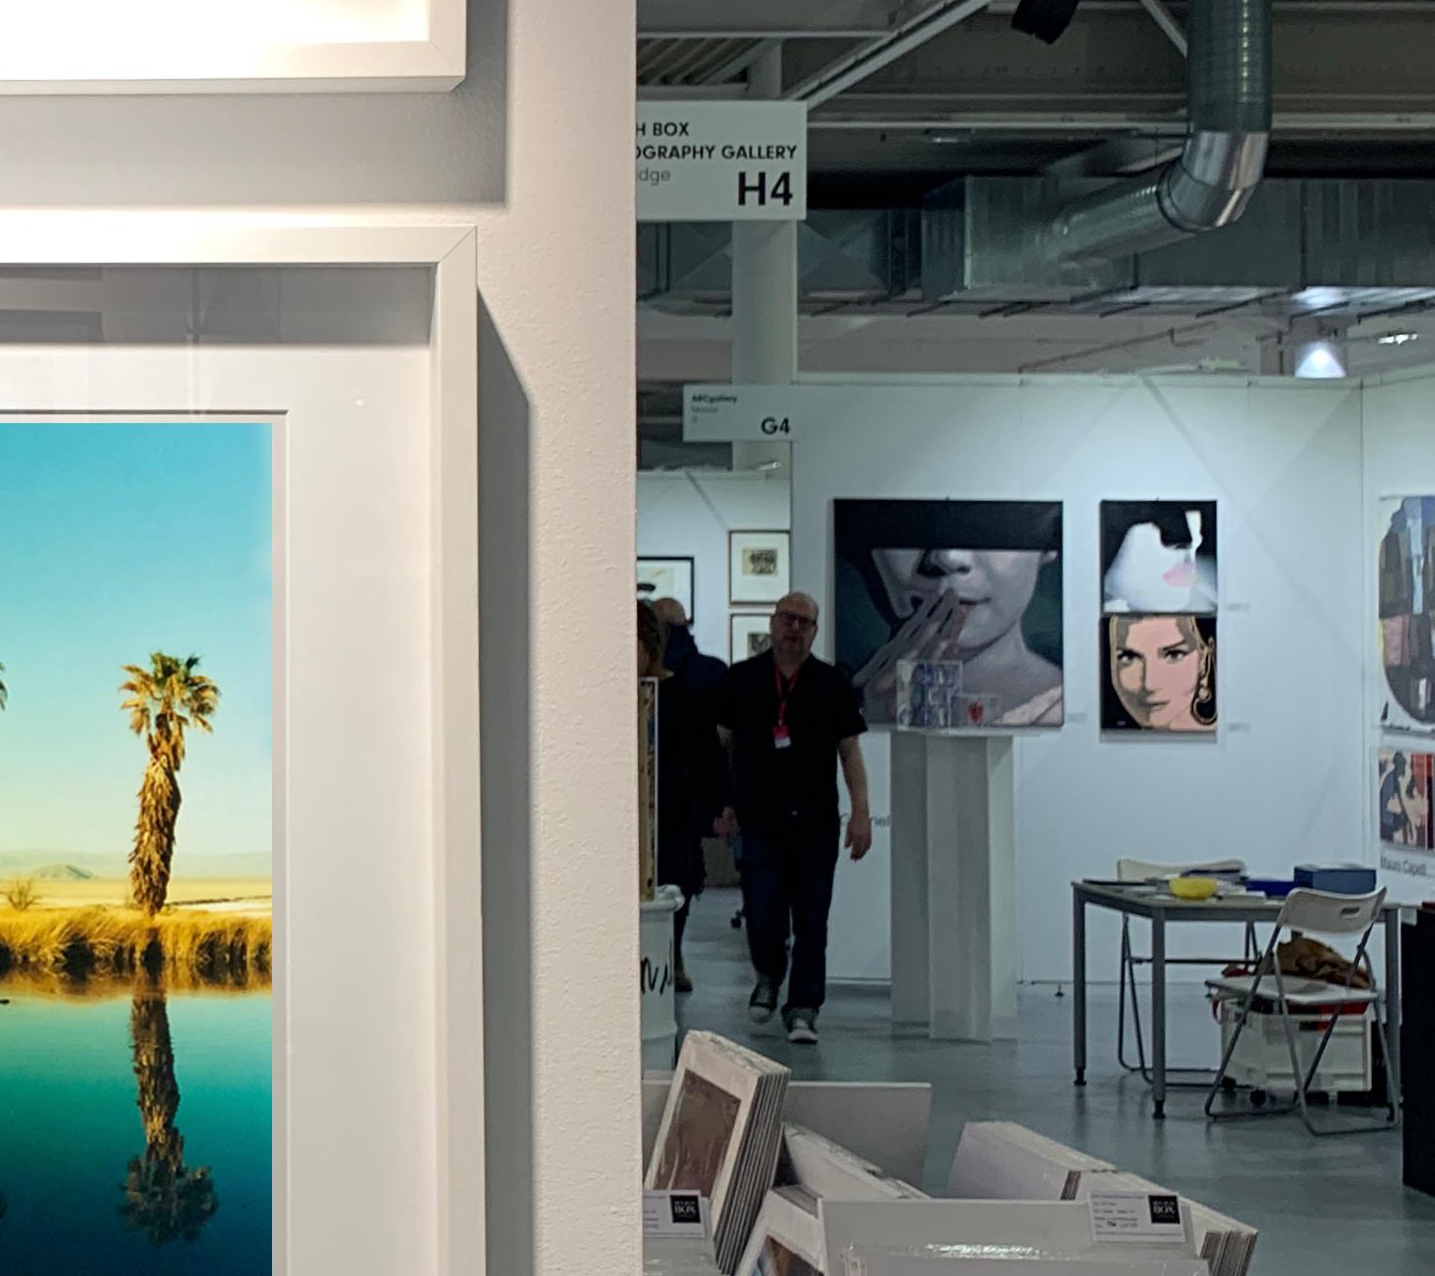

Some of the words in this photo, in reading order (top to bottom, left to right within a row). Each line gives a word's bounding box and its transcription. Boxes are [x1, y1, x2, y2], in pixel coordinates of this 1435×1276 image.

[652, 122, 690, 137] BOX
[721, 145, 797, 160] GALLERY
[738, 171, 794, 206] H4
[761, 416, 790, 435] G4
